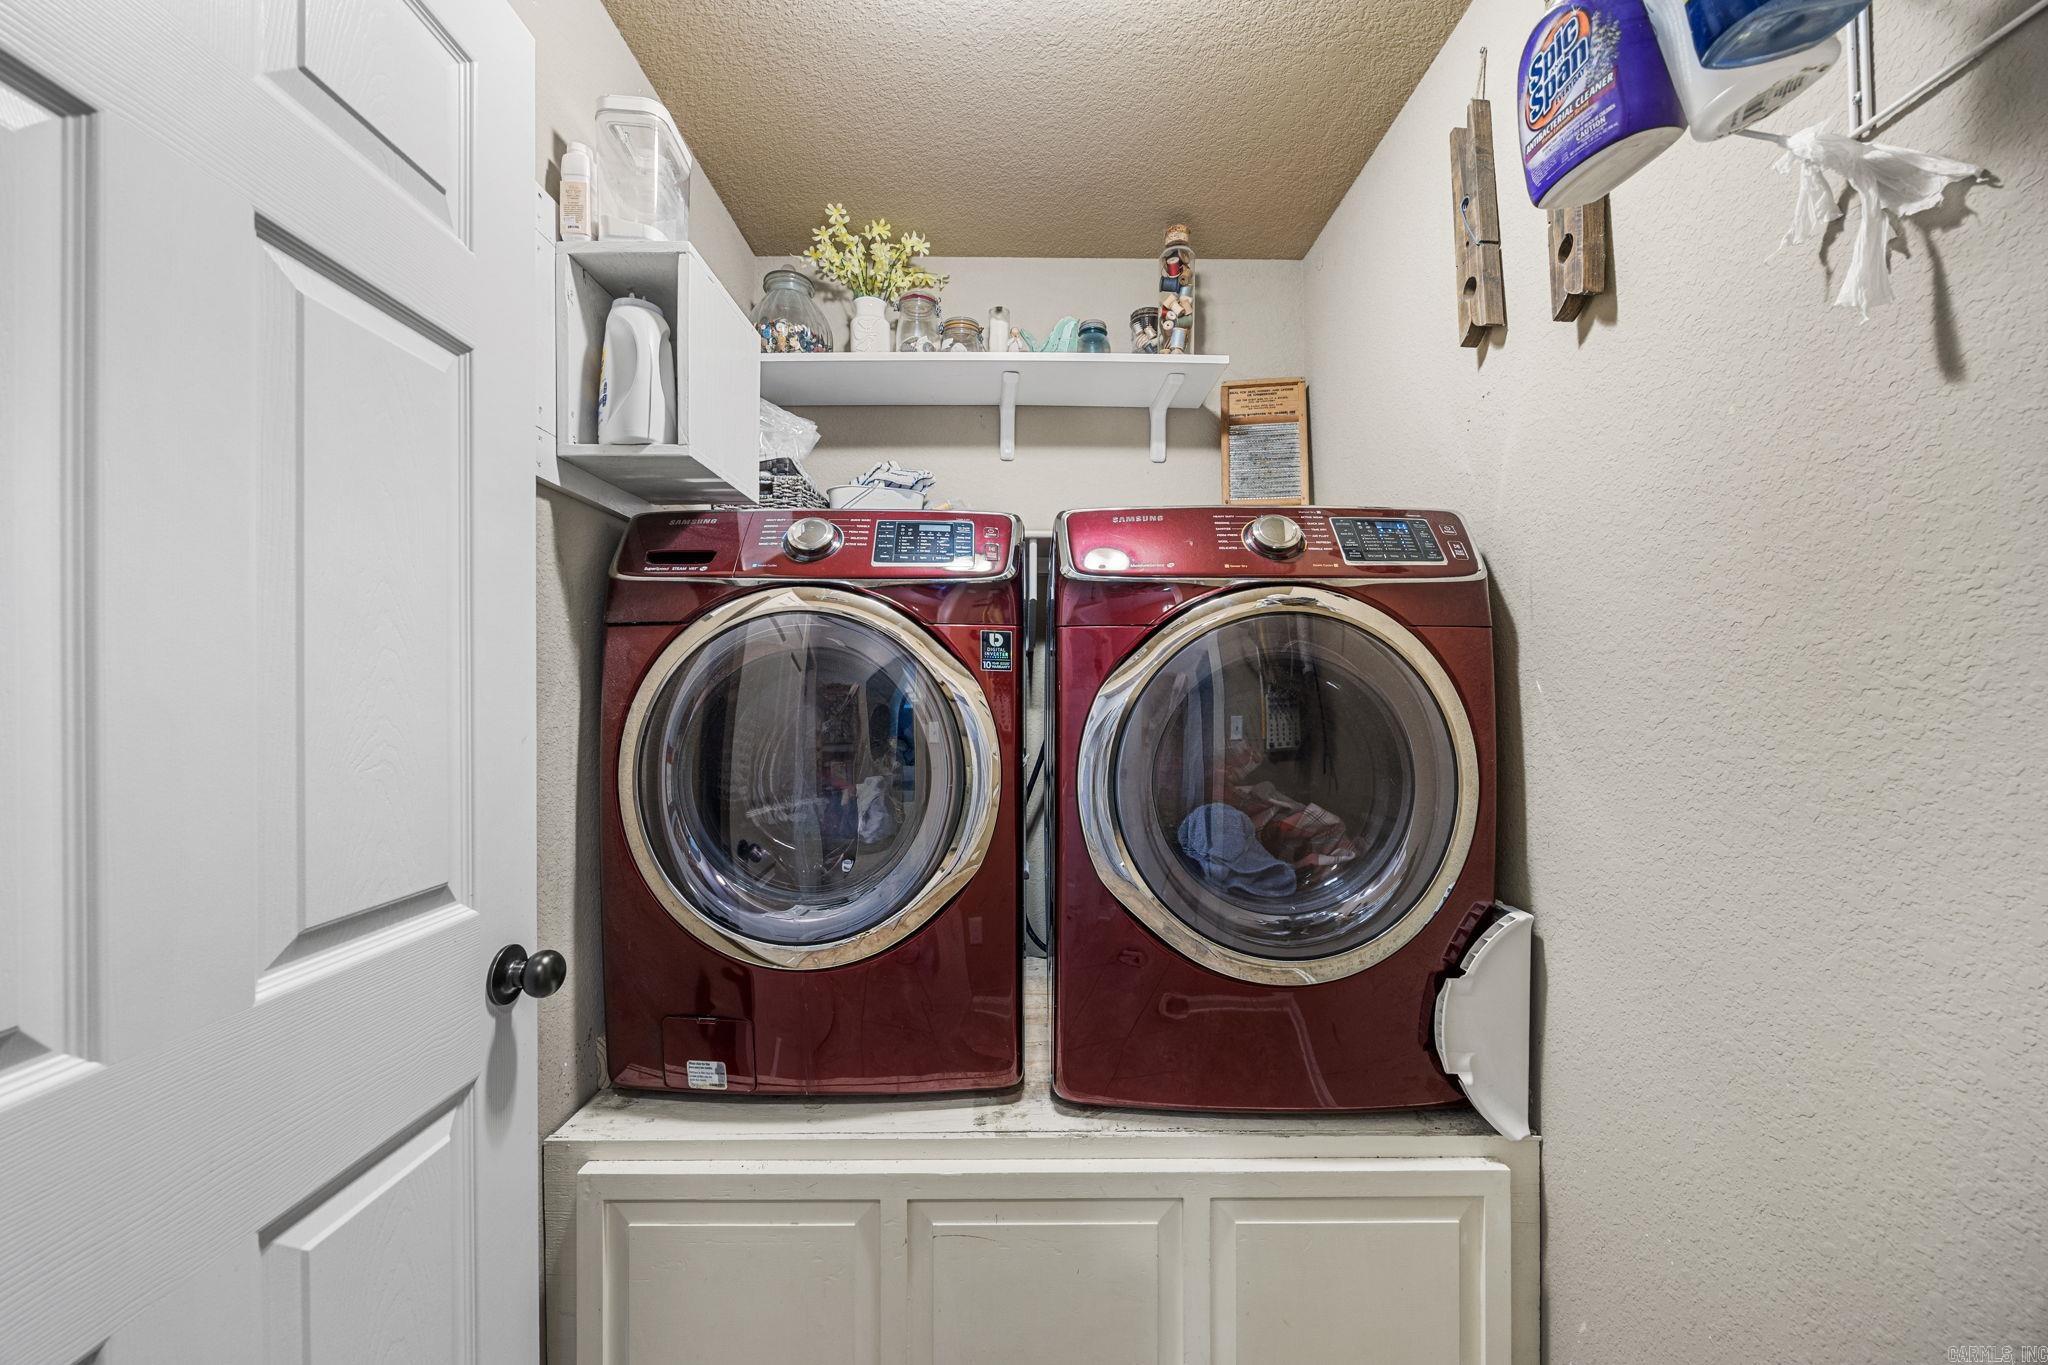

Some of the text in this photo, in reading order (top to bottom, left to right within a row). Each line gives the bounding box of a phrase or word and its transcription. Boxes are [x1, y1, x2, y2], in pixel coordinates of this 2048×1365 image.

[1529, 16, 1579, 92] Spic
[1529, 37, 1590, 123] Span
[1526, 106, 1574, 154] ANTIBACTERIAL
[1575, 72, 1614, 107] CLEANER
[1576, 116, 1606, 140] CAUTION
[668, 518, 718, 526] SAMSUNG
[1112, 515, 1164, 523] SAMSUNG
[982, 661, 992, 669] 10
